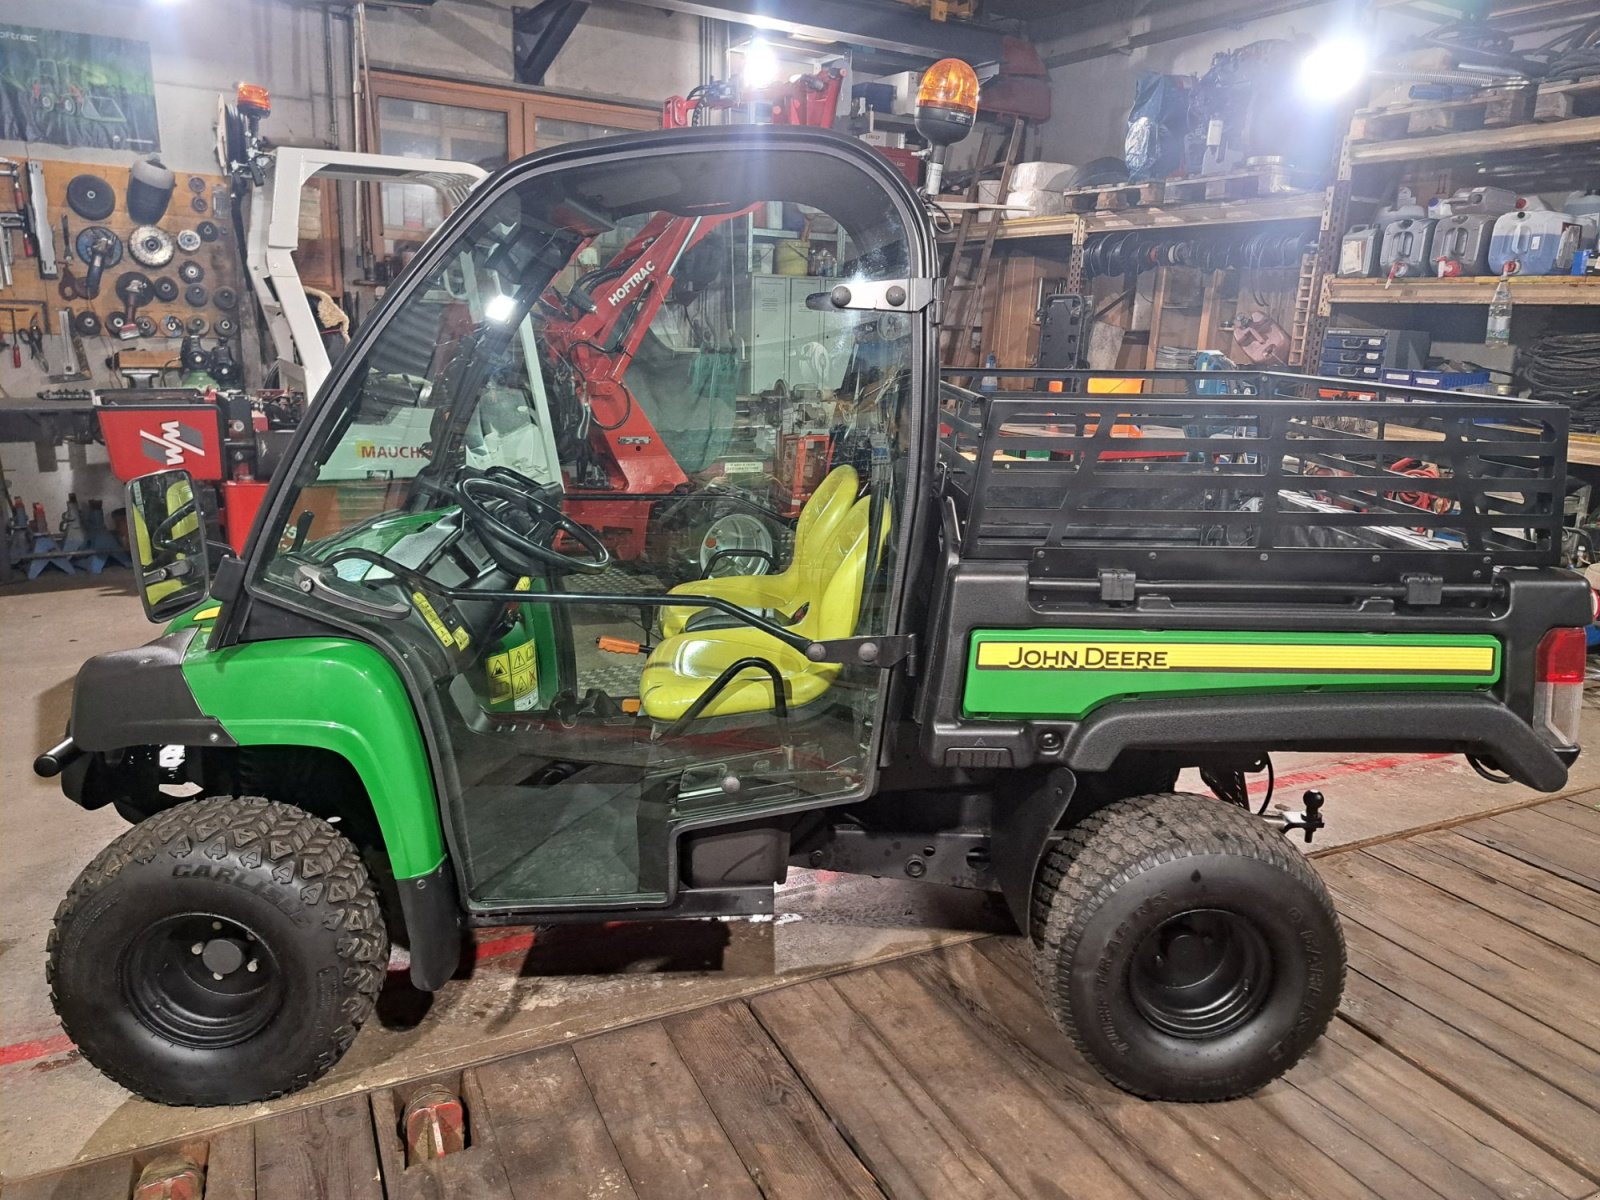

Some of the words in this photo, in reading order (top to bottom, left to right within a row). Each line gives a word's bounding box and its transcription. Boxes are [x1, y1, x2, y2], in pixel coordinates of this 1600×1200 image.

[608, 260, 656, 307] HOFTRAC
[1008, 646, 1078, 666] JOHN
[1085, 647, 1168, 667] DEERE
